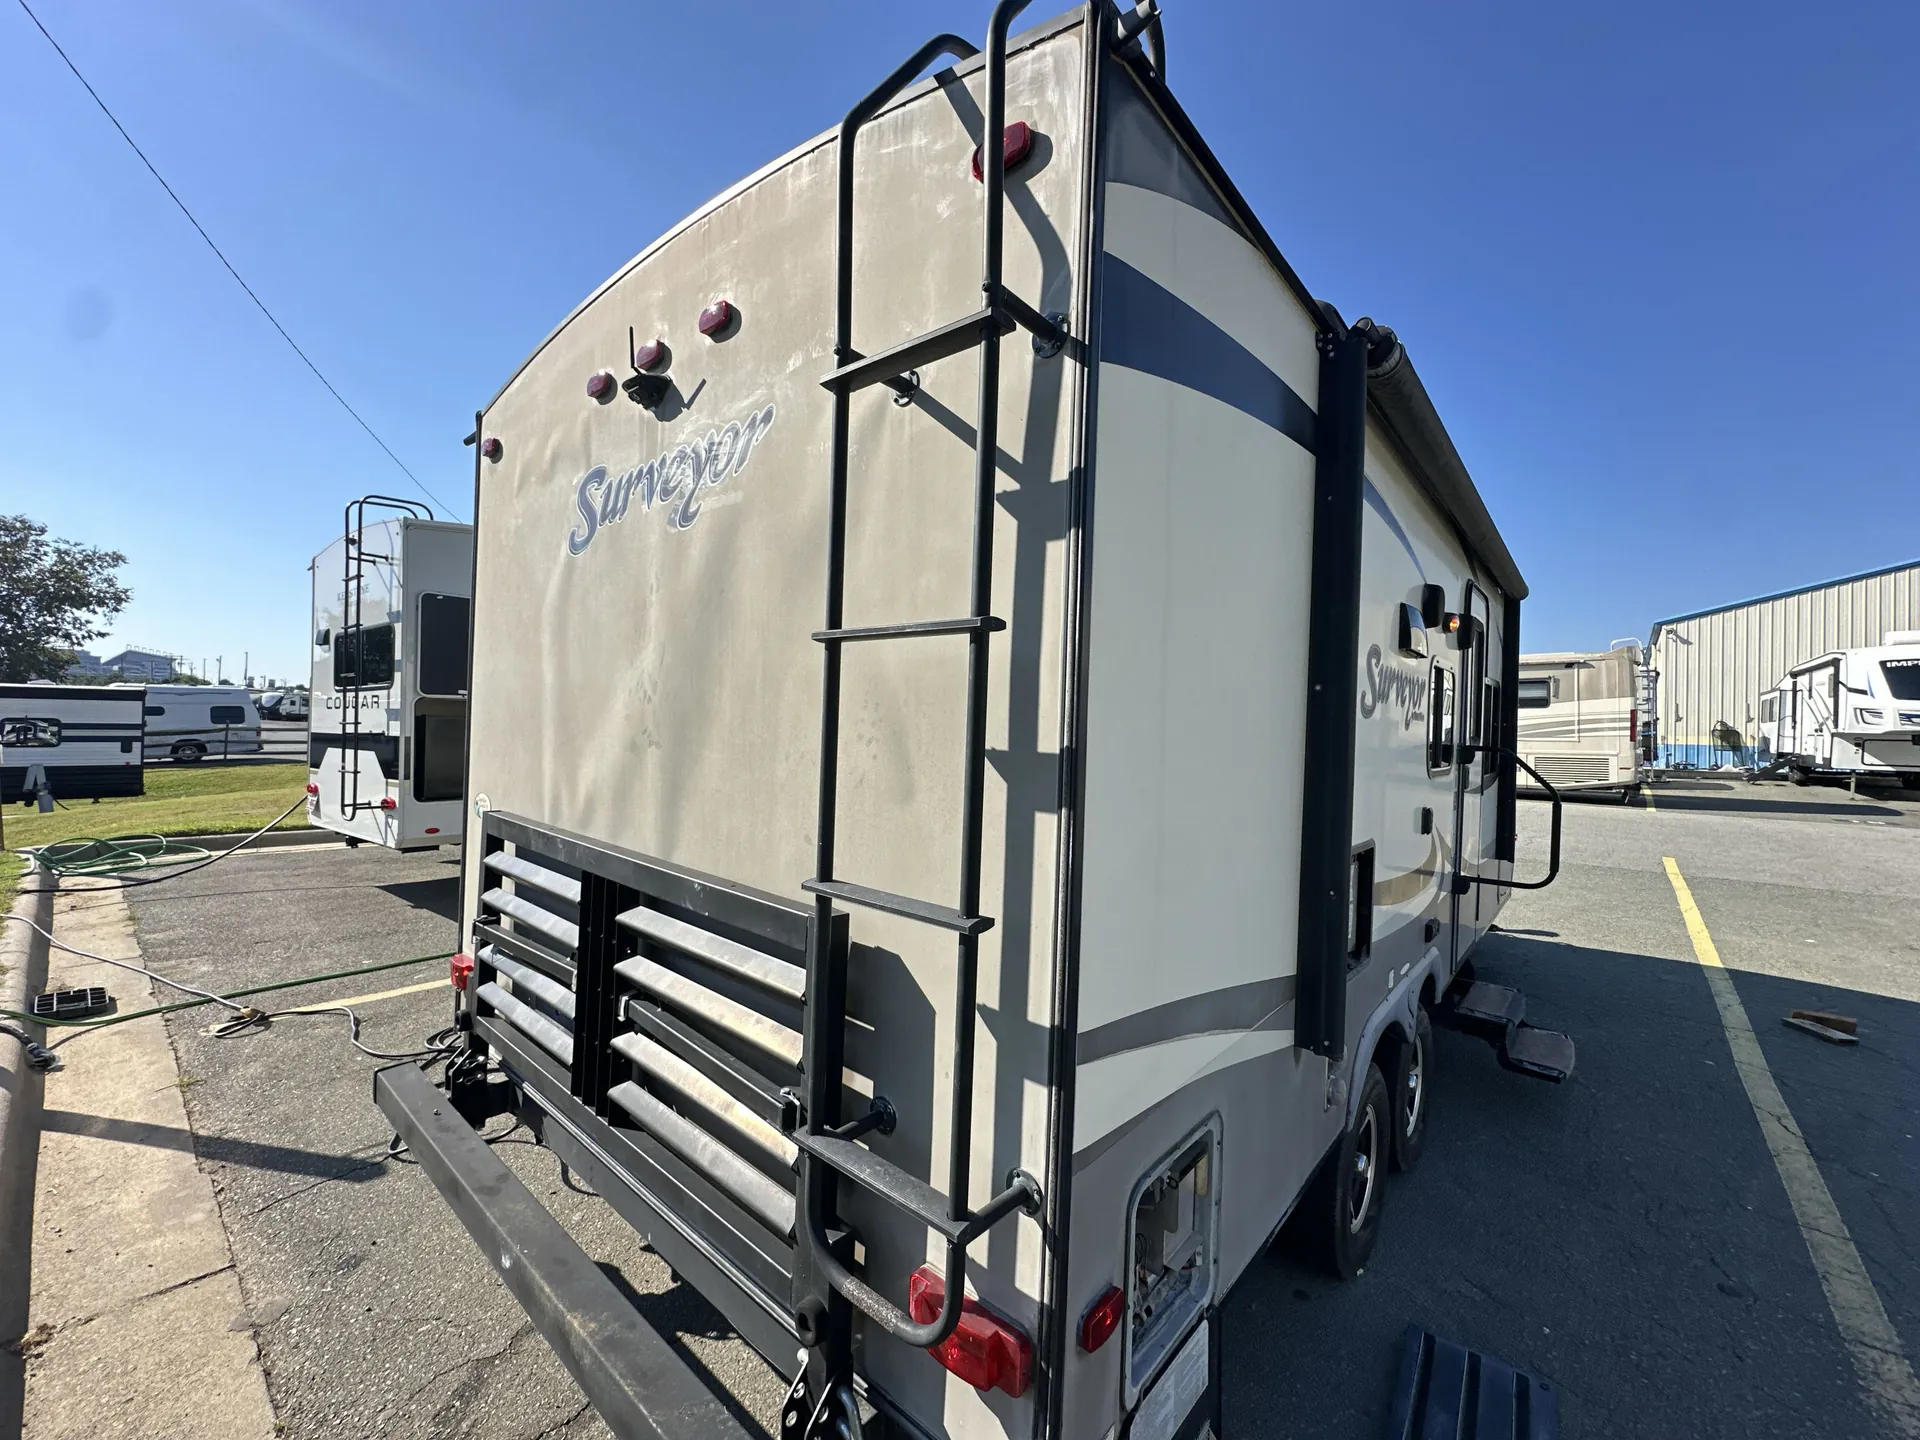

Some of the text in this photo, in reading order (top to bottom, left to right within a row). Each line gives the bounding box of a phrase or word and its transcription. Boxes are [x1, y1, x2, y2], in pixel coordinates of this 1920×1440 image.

[568, 403, 776, 557] Surveyor
[1360, 643, 1427, 731] Surveyor
[1886, 660, 1920, 668] IMP
